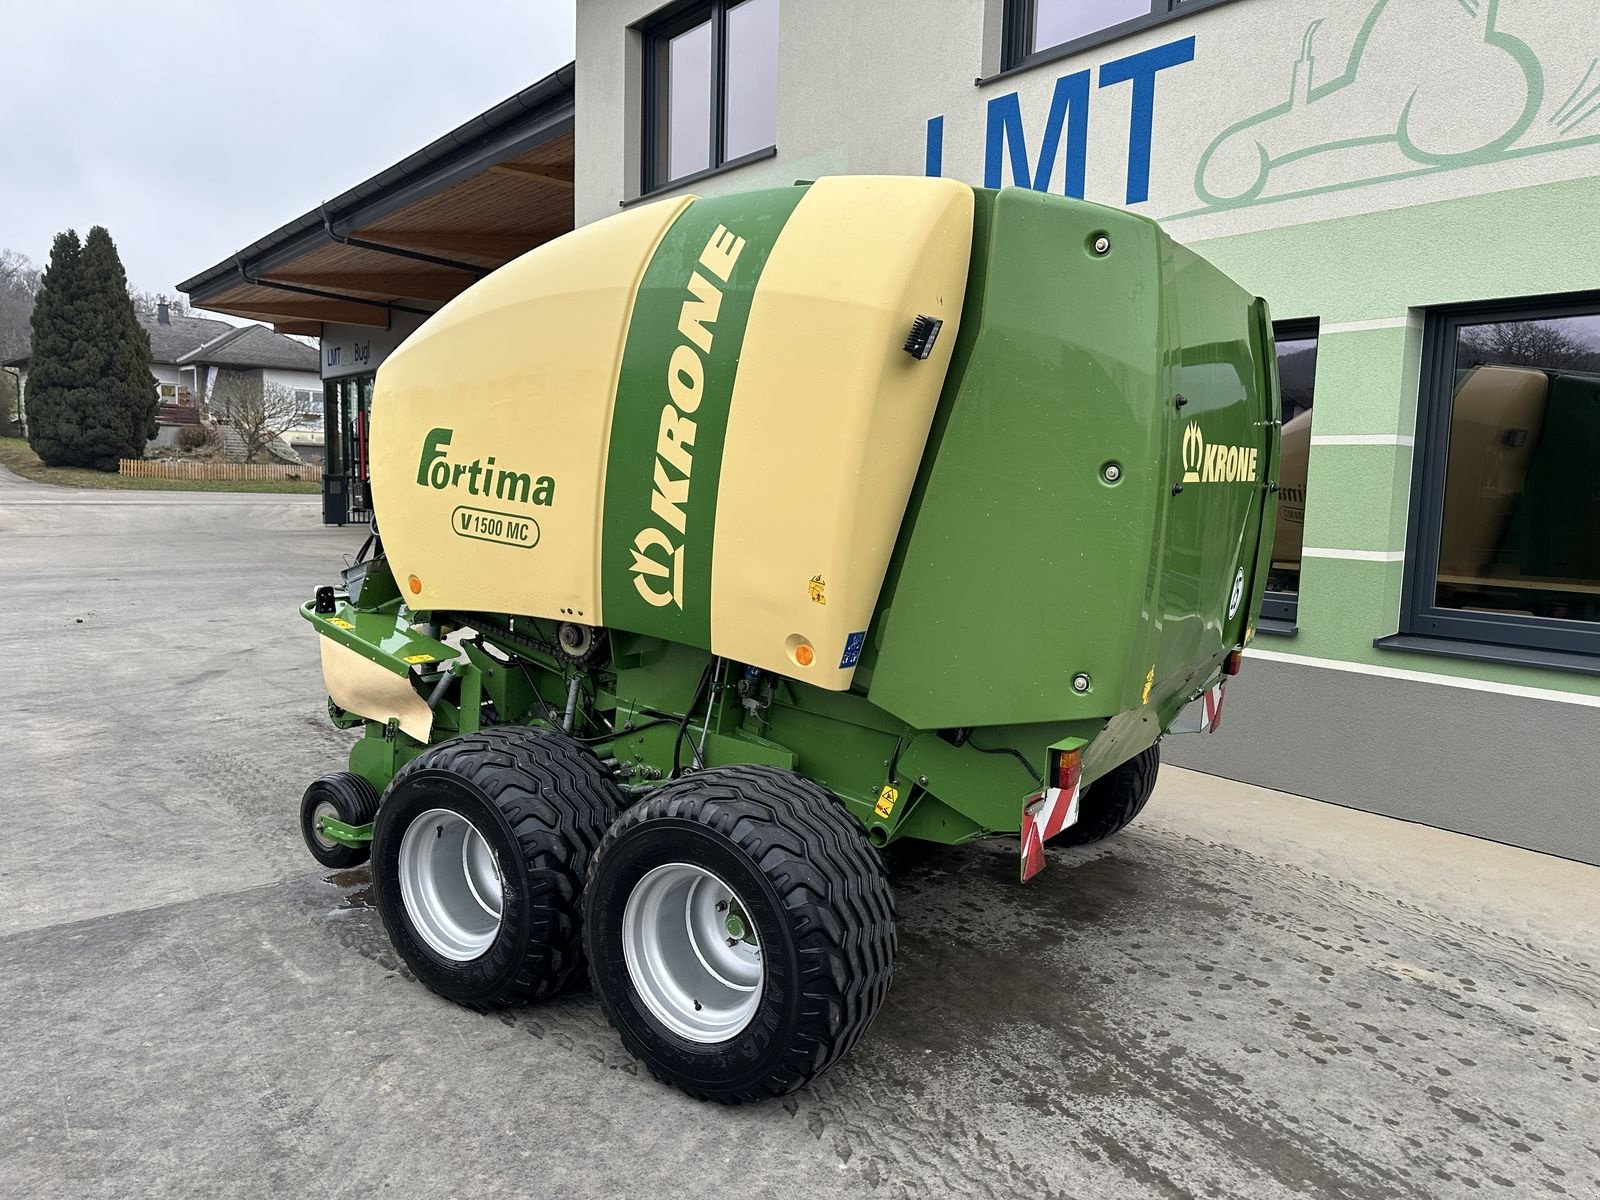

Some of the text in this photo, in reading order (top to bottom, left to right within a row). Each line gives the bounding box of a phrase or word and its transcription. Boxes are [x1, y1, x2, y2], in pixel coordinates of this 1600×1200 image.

[327, 339, 370, 367] LMT Bugl
[651, 223, 746, 535] KRONE
[416, 427, 556, 507] Fortima
[1201, 443, 1258, 483] KRONE
[461, 513, 529, 541] V 1500 MC
